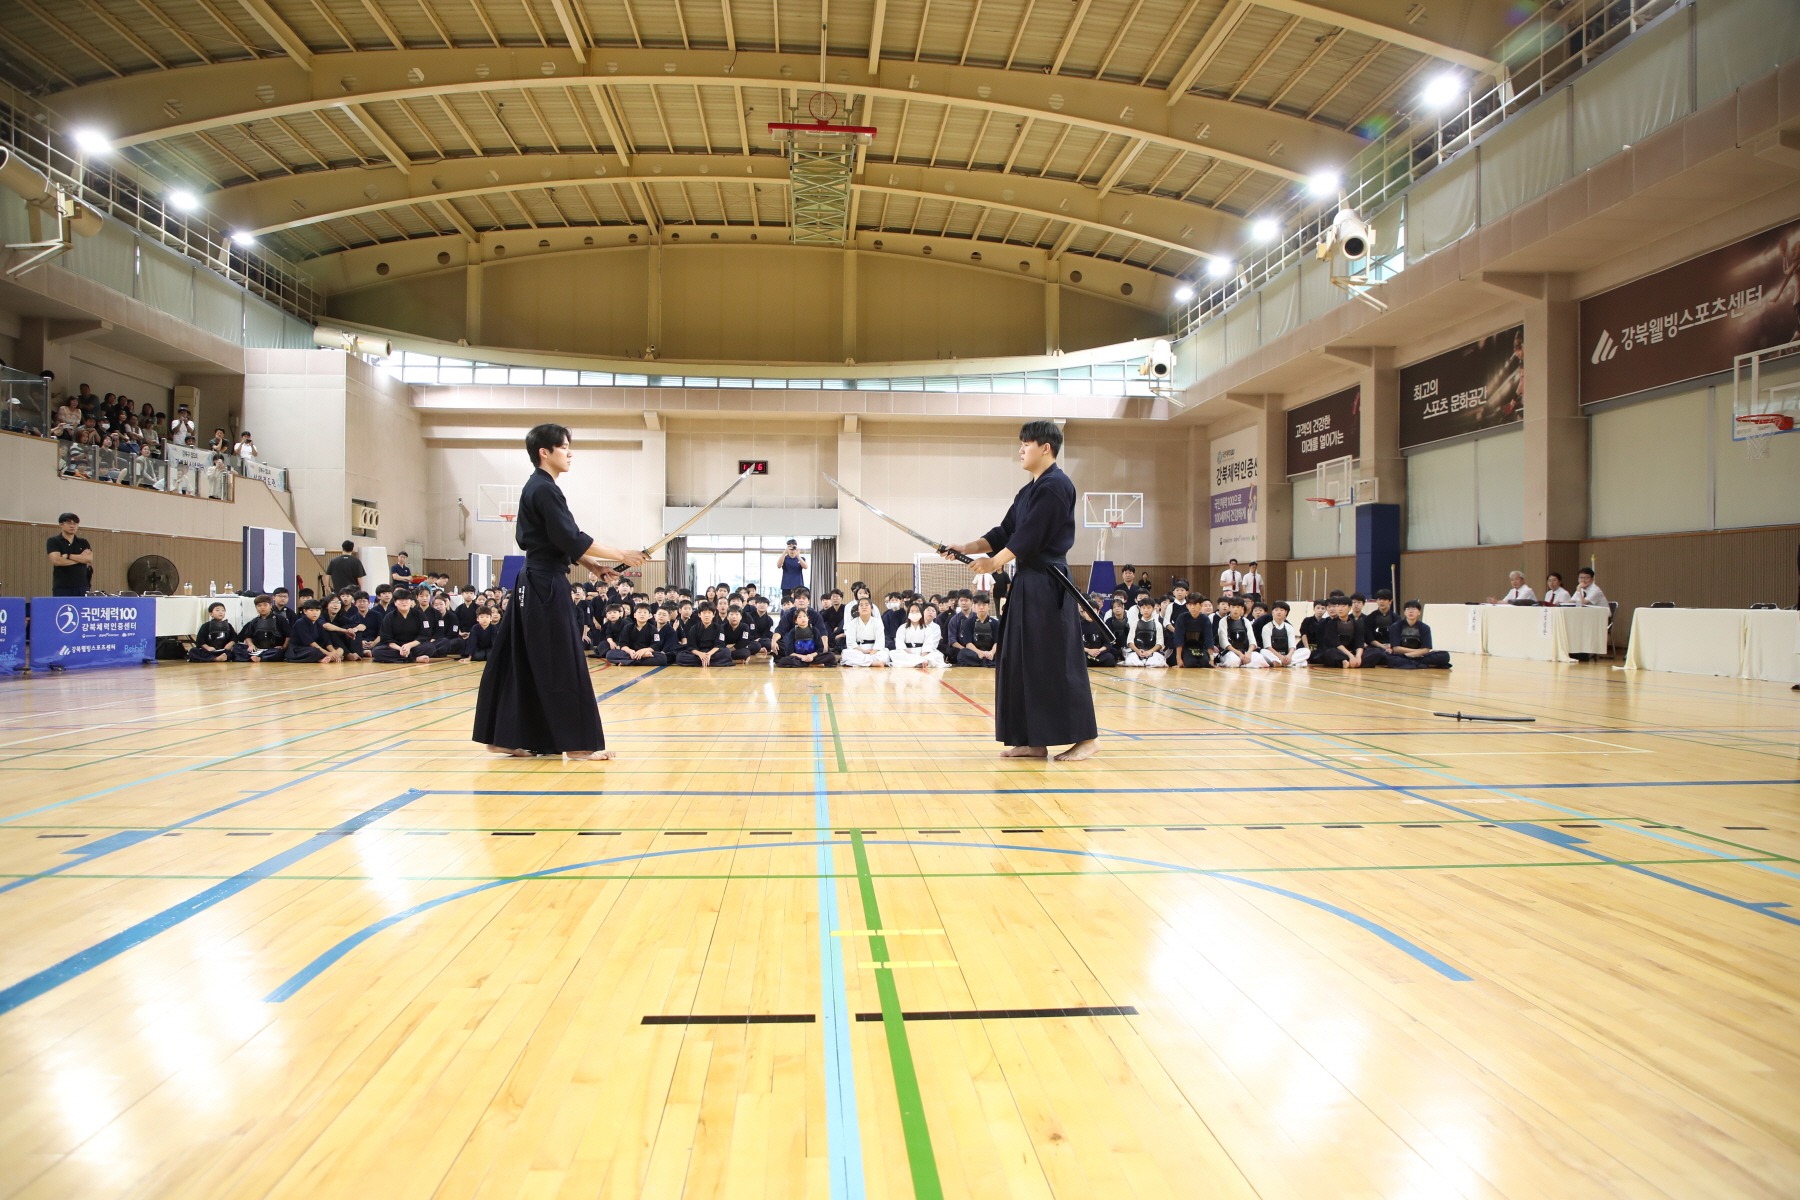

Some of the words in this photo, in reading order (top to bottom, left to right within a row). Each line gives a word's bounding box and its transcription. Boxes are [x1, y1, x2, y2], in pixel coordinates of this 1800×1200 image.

[1621, 284, 1763, 351] 강북웰빙스포츠센터
[1413, 378, 1439, 401] 최고의
[1423, 397, 1449, 420] 스포츠
[1450, 386, 1488, 413] 문화공간
[1295, 421, 1312, 438] 고객의
[1313, 414, 1331, 433] 건강한
[1301, 436, 1318, 454] 미래를
[1320, 430, 1344, 450] 열어가는
[81, 607, 137, 621] 국민체력100
[81, 622, 137, 632] 강북체력인증센터
